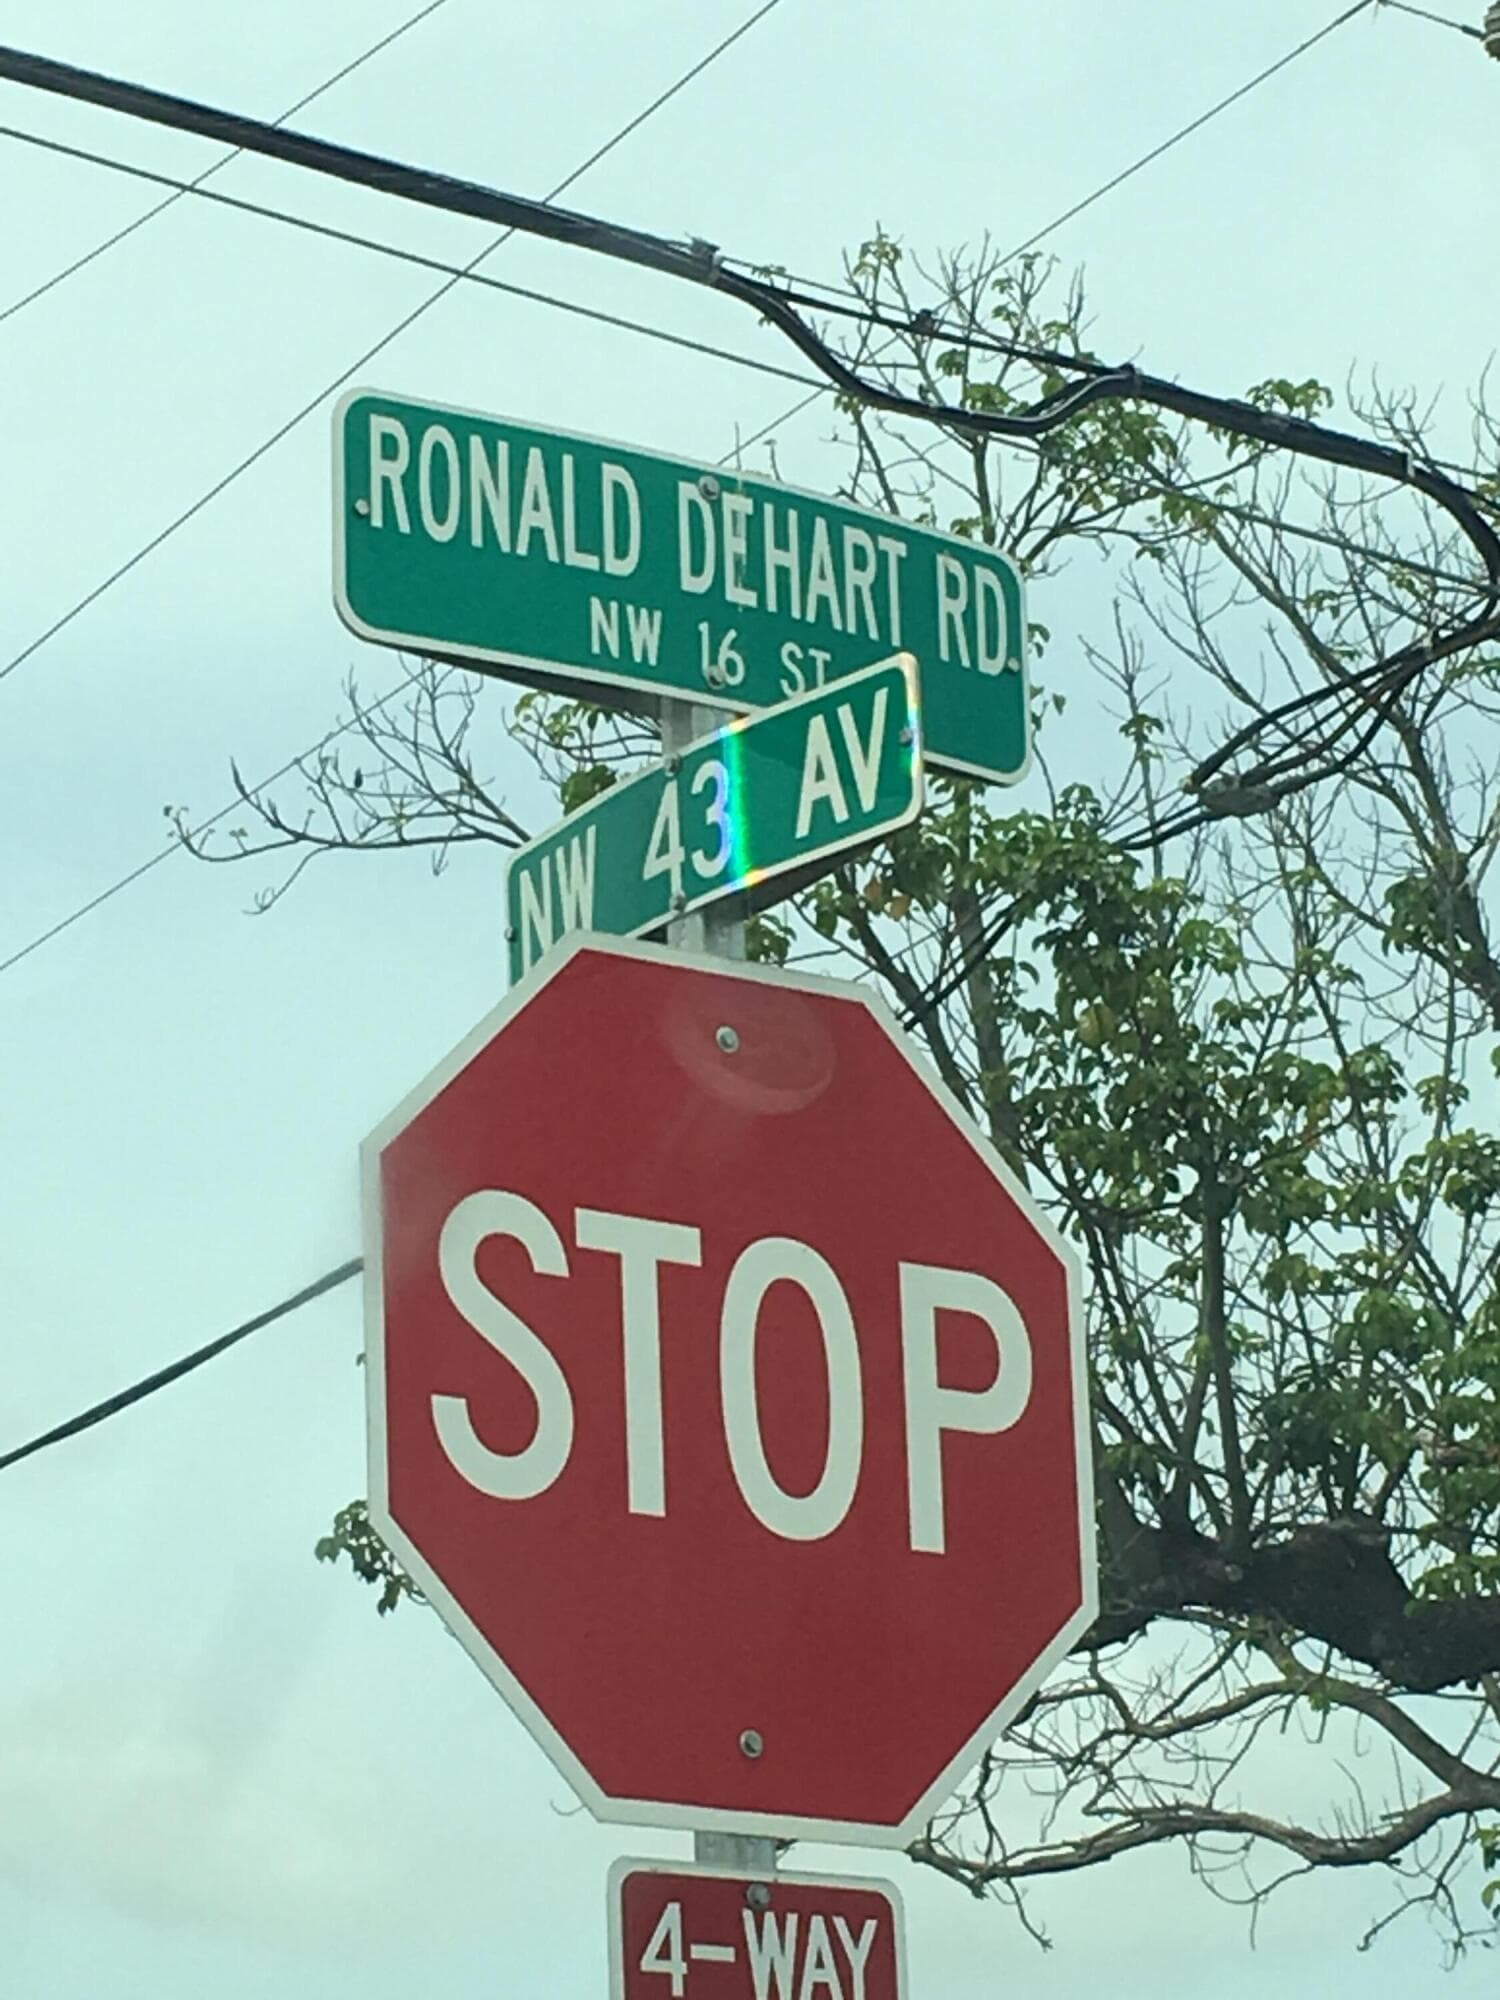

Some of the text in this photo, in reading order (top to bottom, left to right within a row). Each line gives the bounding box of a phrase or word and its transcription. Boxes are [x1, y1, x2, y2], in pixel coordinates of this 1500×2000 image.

[369, 413, 641, 577] RONALD
[678, 478, 907, 646] DEHART
[590, 596, 832, 698] NW 16 ST
[519, 687, 889, 977] NW 43 AV
[430, 1188, 1033, 1555] STOP
[640, 1902, 878, 2000] 4-WAY
